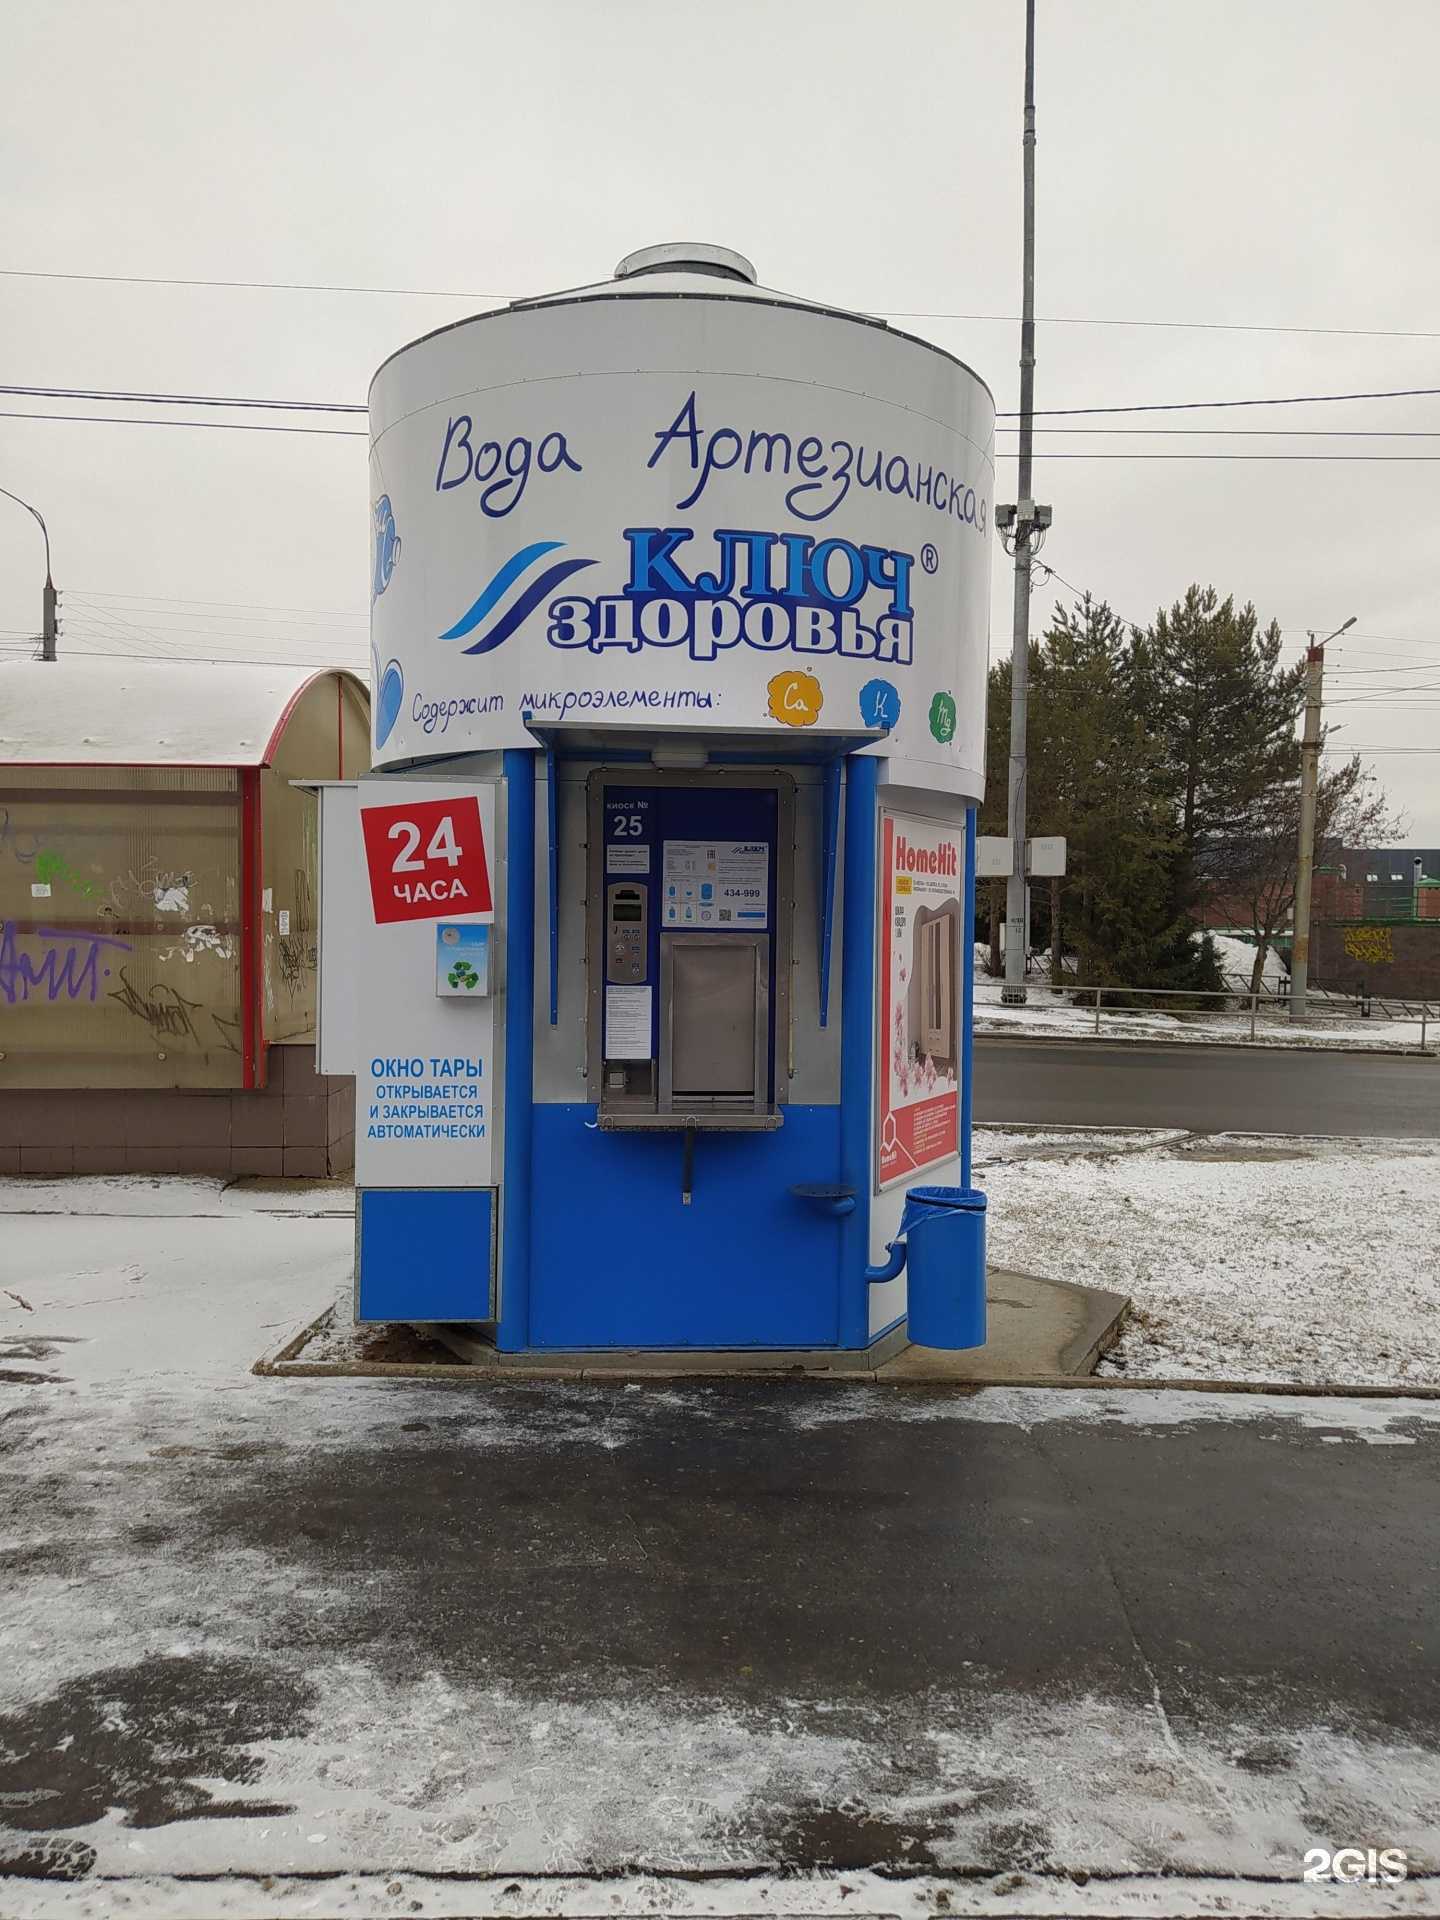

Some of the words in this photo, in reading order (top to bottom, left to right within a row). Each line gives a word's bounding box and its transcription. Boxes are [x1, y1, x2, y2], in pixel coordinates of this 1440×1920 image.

[436, 415, 583, 518] Вода
[647, 390, 987, 533] Артезианская
[546, 595, 914, 665] здоровья
[783, 682, 809, 711] Ca
[873, 691, 889, 718] K
[412, 693, 504, 733] Содержит
[518, 690, 722, 721] микроэлементы:
[937, 700, 952, 736] Mg
[613, 815, 643, 836] 25
[388, 816, 463, 873] 24
[895, 836, 957, 876] HomeHit
[393, 878, 468, 904] ЧАСА
[724, 888, 761, 898] 434-999
[371, 1058, 424, 1077] ОКНО
[430, 1058, 482, 1077] ТАРЫ
[376, 1085, 478, 1099] ОТКРЫВАЕТСЯ
[369, 1105, 379, 1118] И
[383, 1105, 484, 1118] ЗАКРЫВАЕТСЯ
[368, 1124, 485, 1138] АВТОМАТИЧЕСКИ
